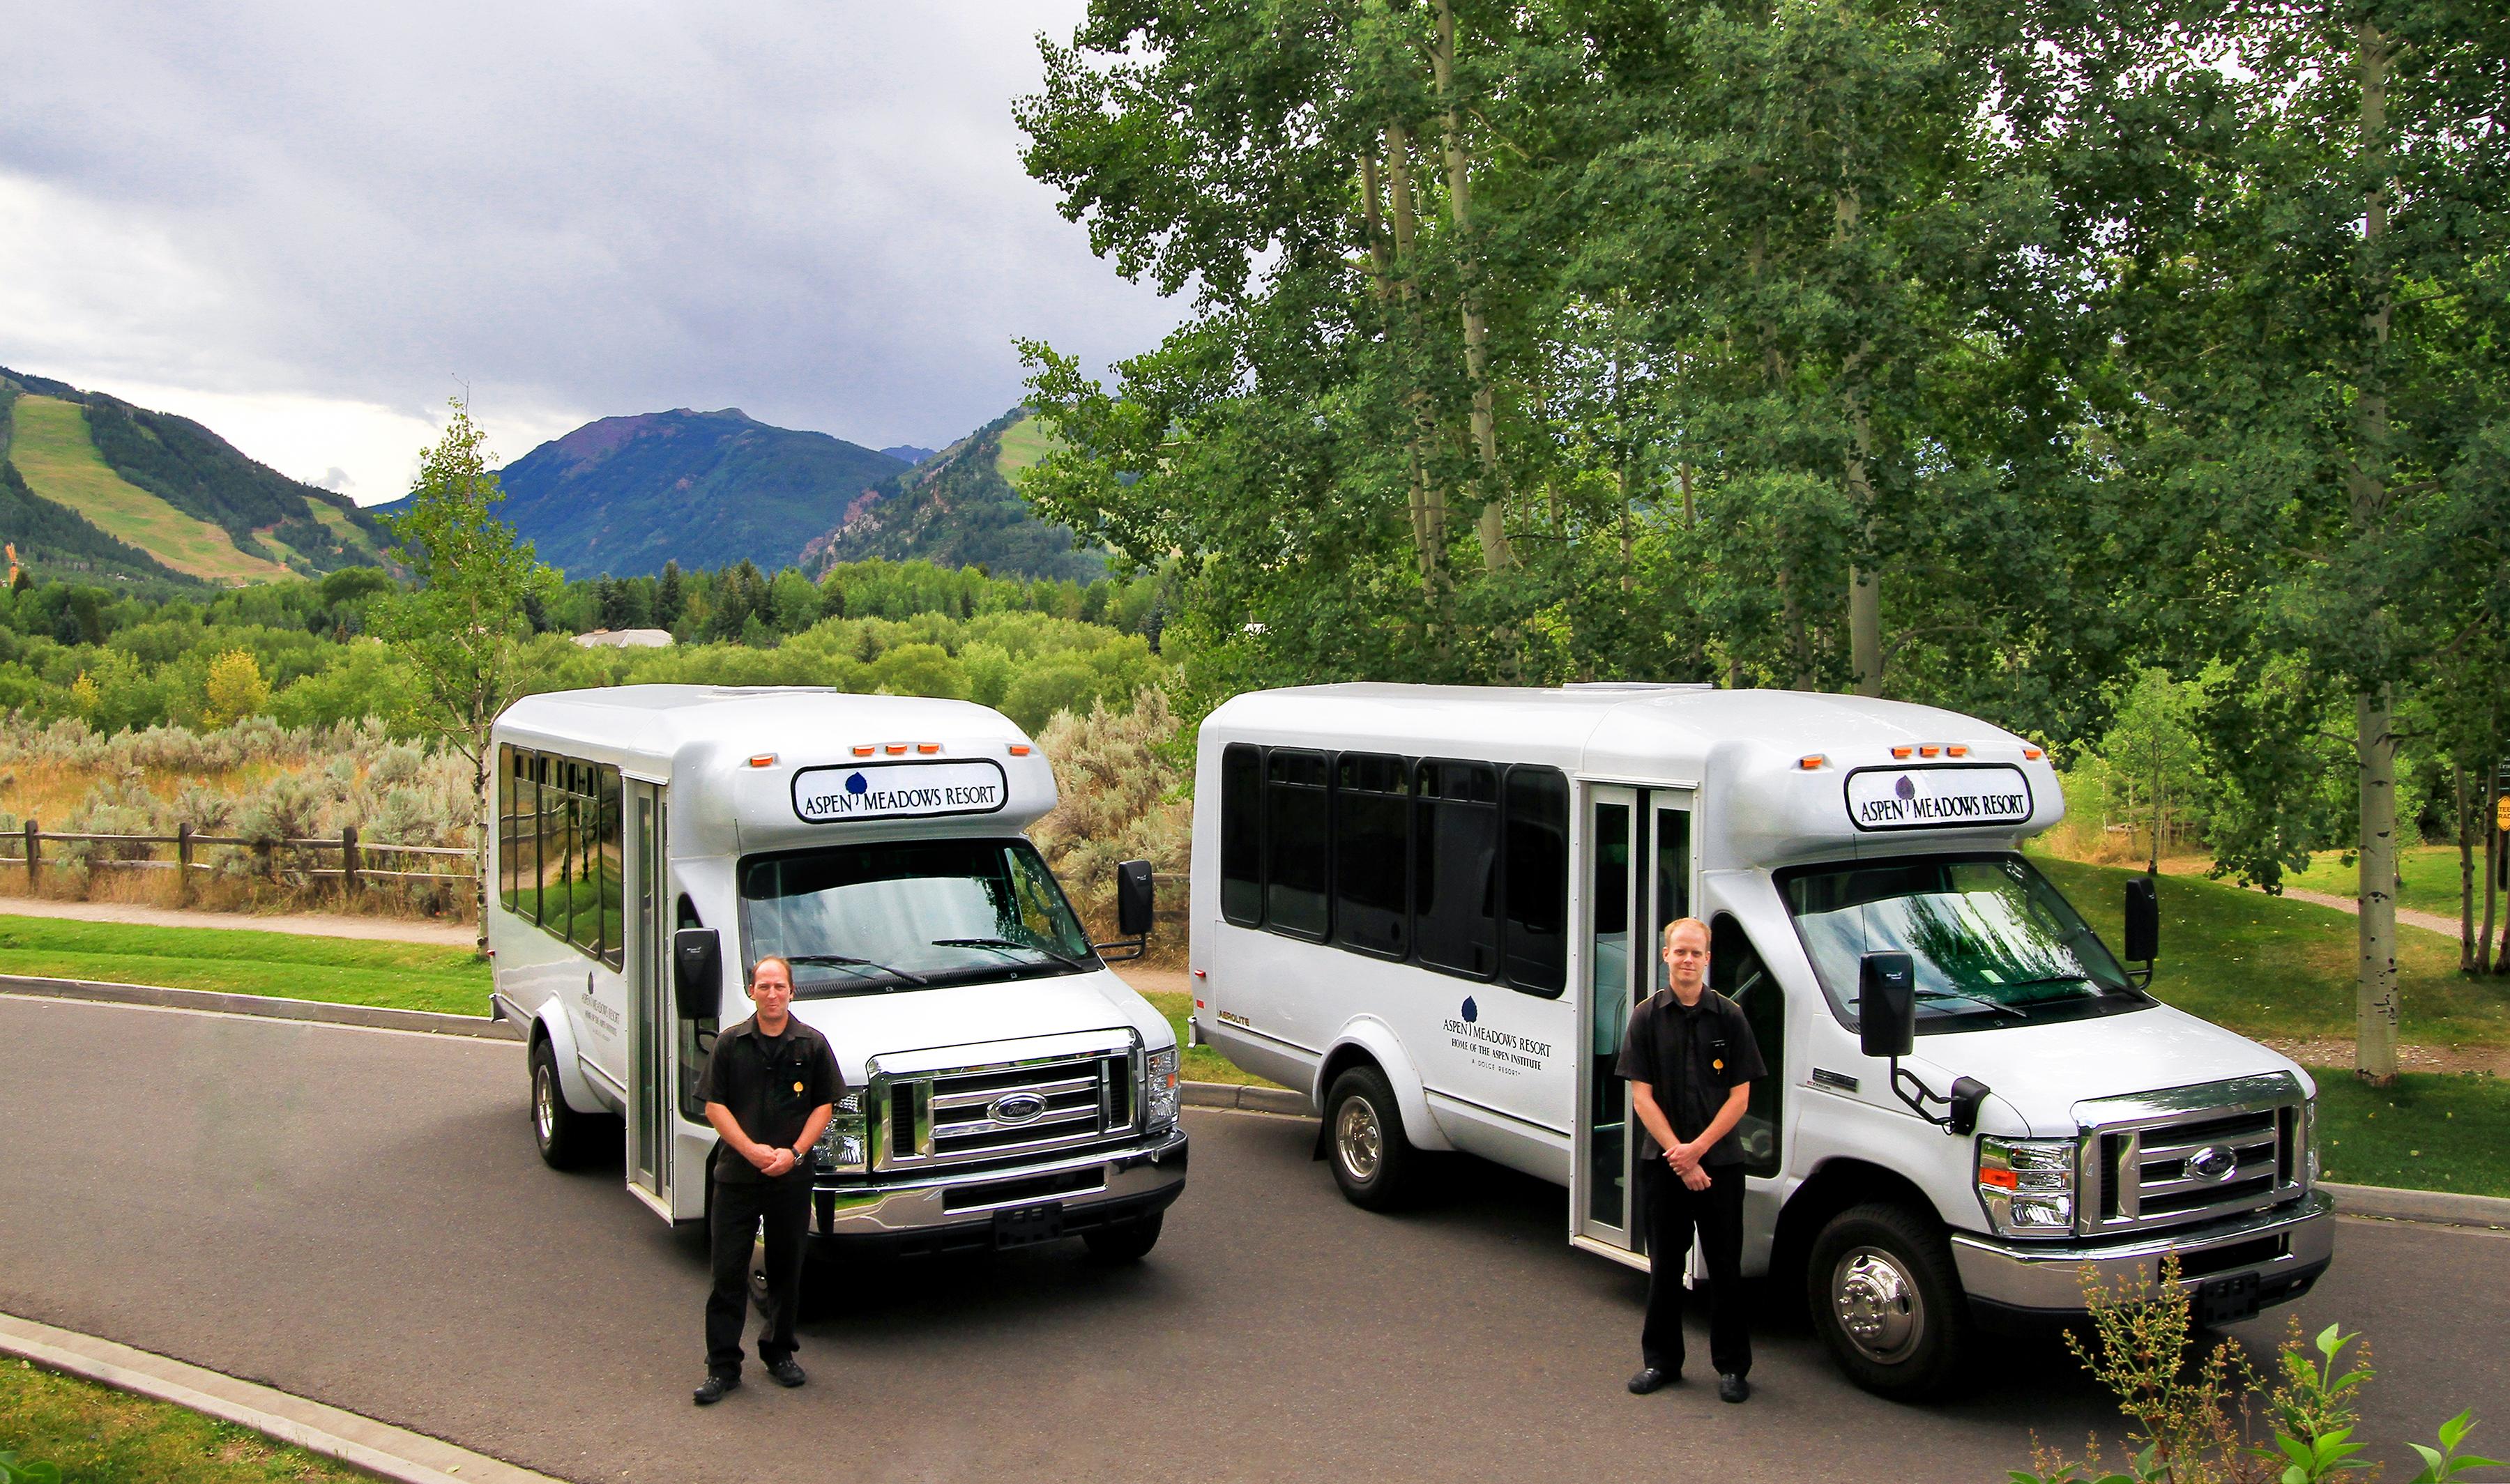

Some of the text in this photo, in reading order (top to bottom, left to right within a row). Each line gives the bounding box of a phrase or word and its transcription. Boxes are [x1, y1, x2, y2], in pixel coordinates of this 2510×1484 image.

[805, 786, 996, 815] ASPEN MEADOWS RESORT
[1862, 795, 2025, 821] ASPEN MEADOWS RESORT
[1443, 1019, 1551, 1057] ASPEN MEADOWS RESORT
[1452, 1038, 1542, 1071] HOME OF THE ASPEN INSTITUTE
[1007, 1103, 1033, 1115] Ford
[2206, 1159, 2227, 1171] Ford
